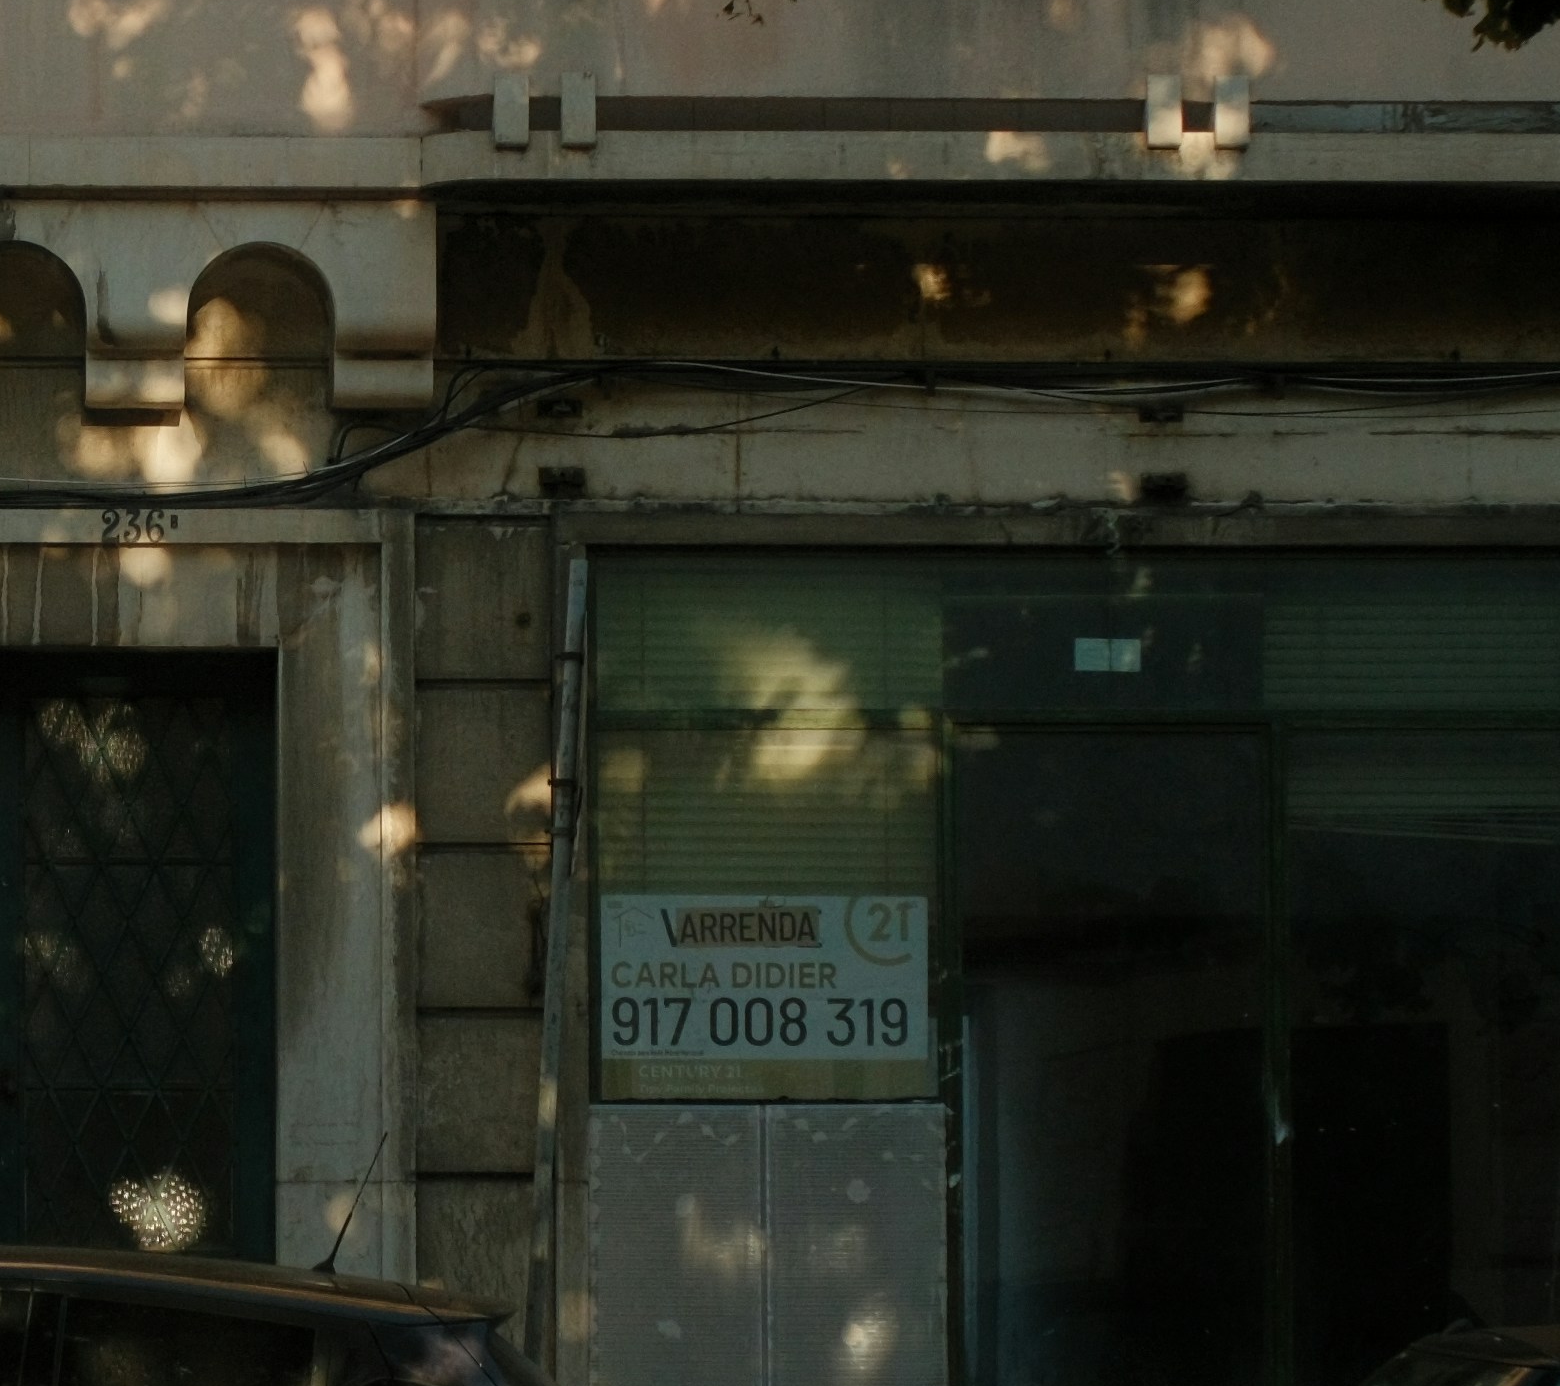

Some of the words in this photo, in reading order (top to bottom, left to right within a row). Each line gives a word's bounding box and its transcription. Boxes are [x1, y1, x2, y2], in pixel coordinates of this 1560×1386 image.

[679, 910, 816, 943] ARRENDA
[867, 901, 910, 942] 21
[611, 961, 720, 989] CARLA
[731, 961, 837, 989] DIDIER
[611, 996, 691, 1046] 917
[709, 996, 808, 1046] 008
[826, 997, 908, 1046] 319
[638, 1065, 722, 1078] CENTURY
[726, 1065, 741, 1078] 21
